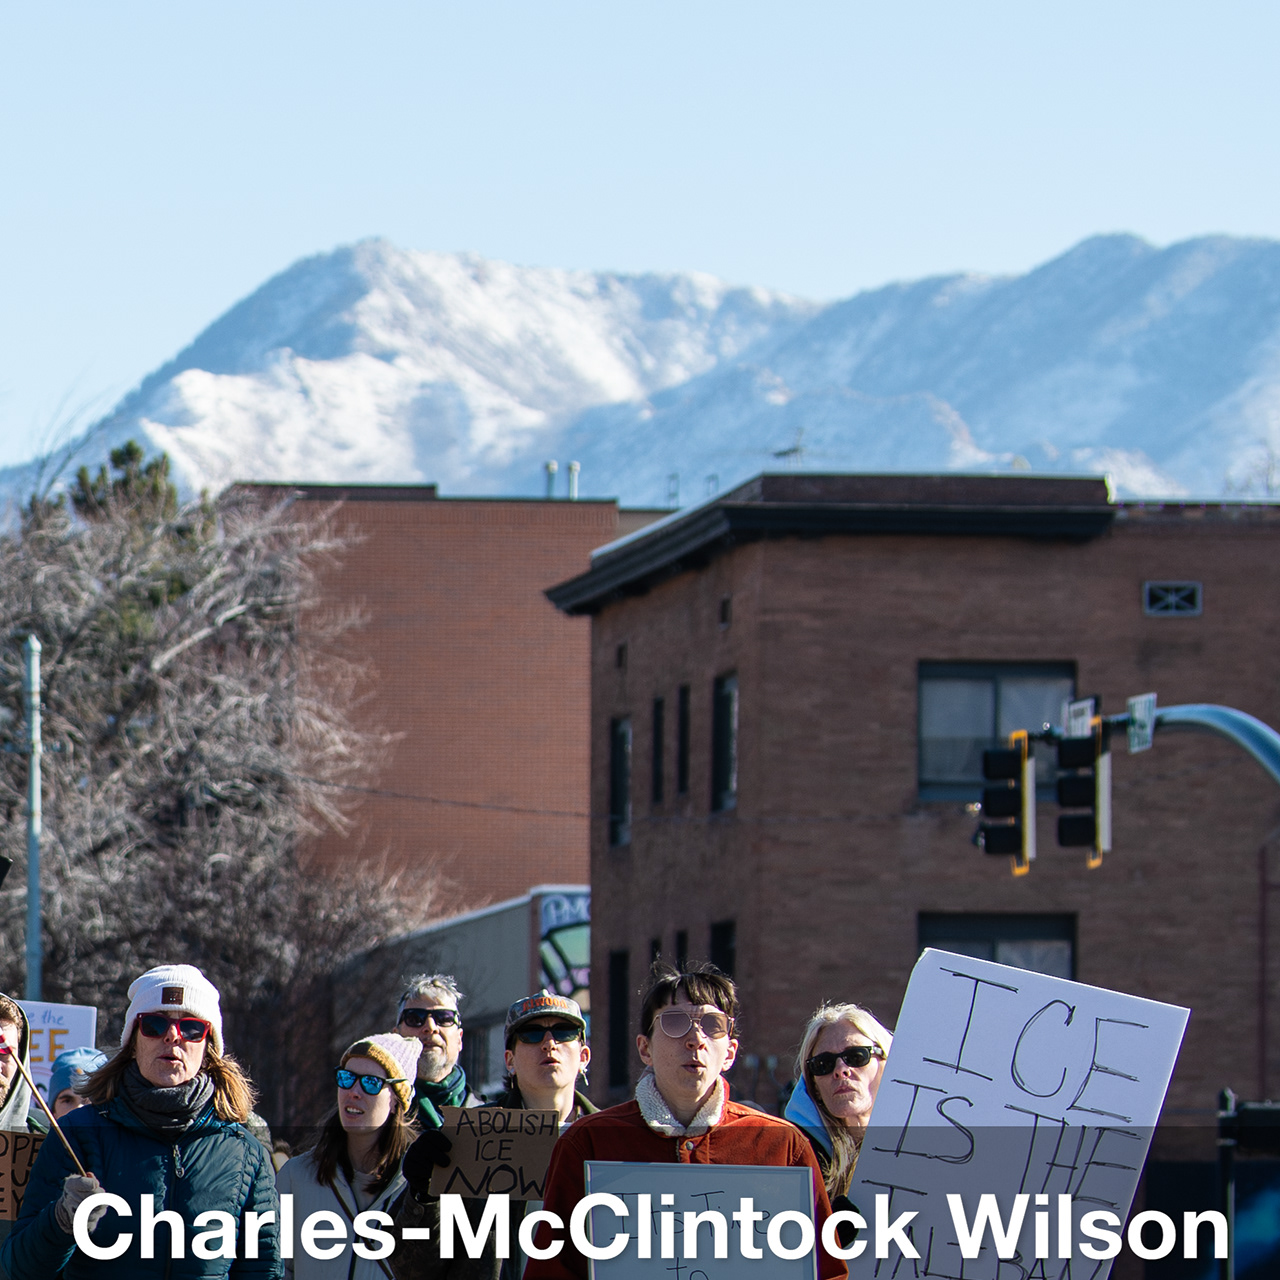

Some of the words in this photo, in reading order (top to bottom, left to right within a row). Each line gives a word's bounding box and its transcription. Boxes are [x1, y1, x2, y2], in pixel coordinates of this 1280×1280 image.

[922, 967, 1150, 1124] ICE
[456, 1109, 557, 1137] ABOLISH
[475, 1139, 514, 1162] ICE
[871, 1078, 976, 1165] IS
[1003, 1104, 1145, 1212] THE
[443, 1163, 551, 1199] NOW
